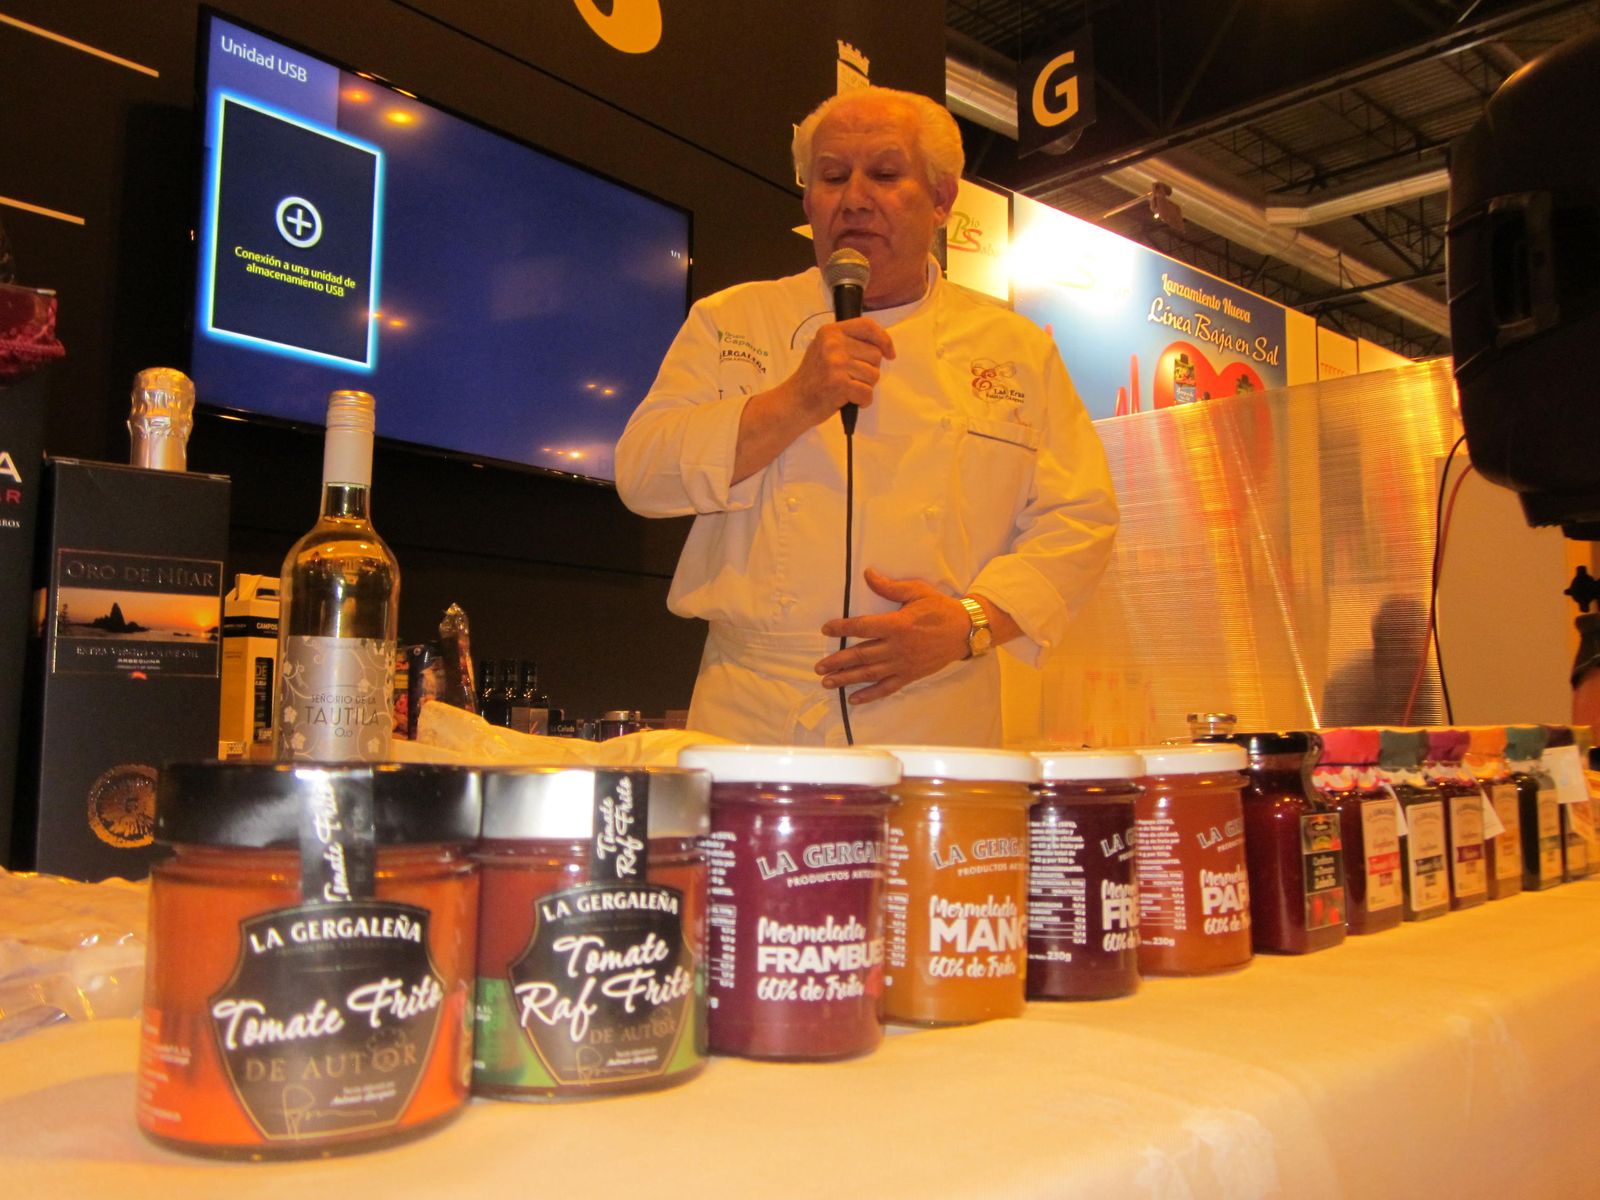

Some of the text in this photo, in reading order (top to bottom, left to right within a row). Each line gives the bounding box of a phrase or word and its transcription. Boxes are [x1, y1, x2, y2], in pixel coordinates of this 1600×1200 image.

[221, 35, 308, 82] Unidad USB
[1031, 50, 1080, 127] G
[234, 246, 356, 289] Conexión a una unidad de
[246, 262, 344, 297] almacenamiento USB
[1161, 273, 1252, 324] Lanzamiento Nueva
[1147, 296, 1280, 366] Línea Baja en Sal
[66, 560, 116, 580] ORO
[124, 566, 150, 583] DE
[305, 705, 380, 726] TAUTILA
[1100, 833, 1125, 858] LA
[1196, 826, 1223, 849] LA
[756, 850, 799, 880] LA
[931, 844, 968, 871] LA
[786, 870, 850, 888] PRODUCTOS
[542, 900, 572, 923] LA
[576, 890, 679, 915] GERGALEÑA
[929, 894, 1018, 919] Mermelada
[250, 926, 285, 954] LA
[290, 914, 422, 944] GERGALEÑA
[758, 915, 867, 945] Mermelada
[1204, 916, 1230, 935] 60%
[552, 933, 669, 978] Tomate
[929, 955, 966, 977] 60%
[966, 956, 986, 977] de
[757, 973, 865, 1001] 60% de Fruta
[212, 976, 444, 1051] Tomate Frito
[514, 966, 693, 1043] Raf Frito
[245, 1058, 287, 1083] DE
